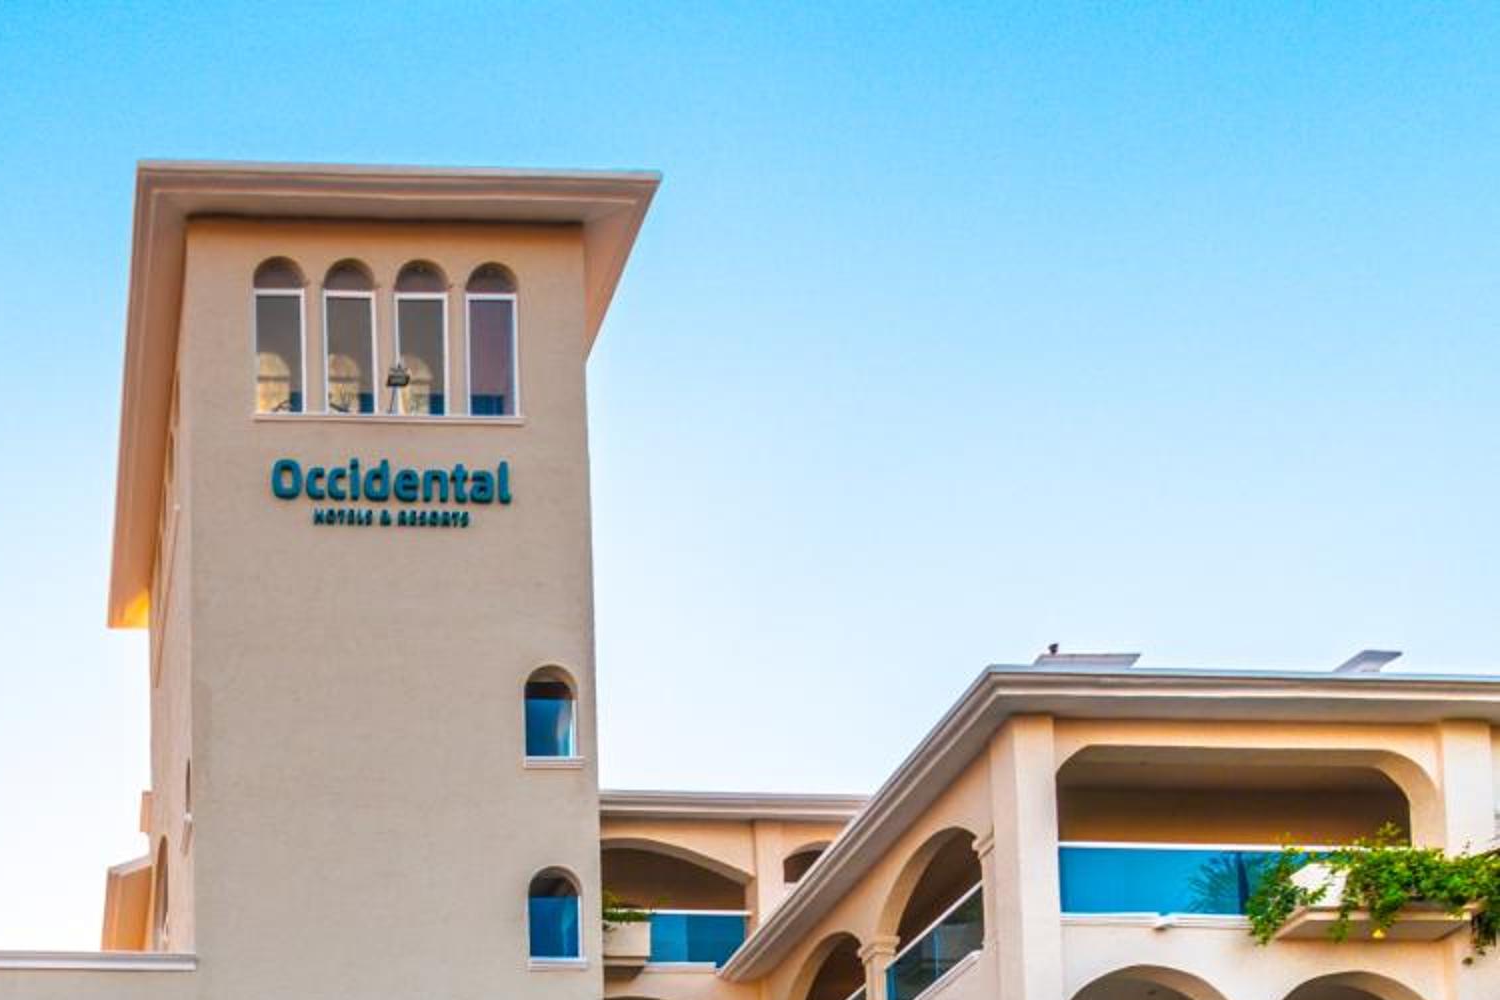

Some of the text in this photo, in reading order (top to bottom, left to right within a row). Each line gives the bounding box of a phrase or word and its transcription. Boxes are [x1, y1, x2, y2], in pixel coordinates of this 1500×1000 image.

[271, 458, 512, 504] Occidental
[313, 508, 469, 528] HOTELS & RESORTS
